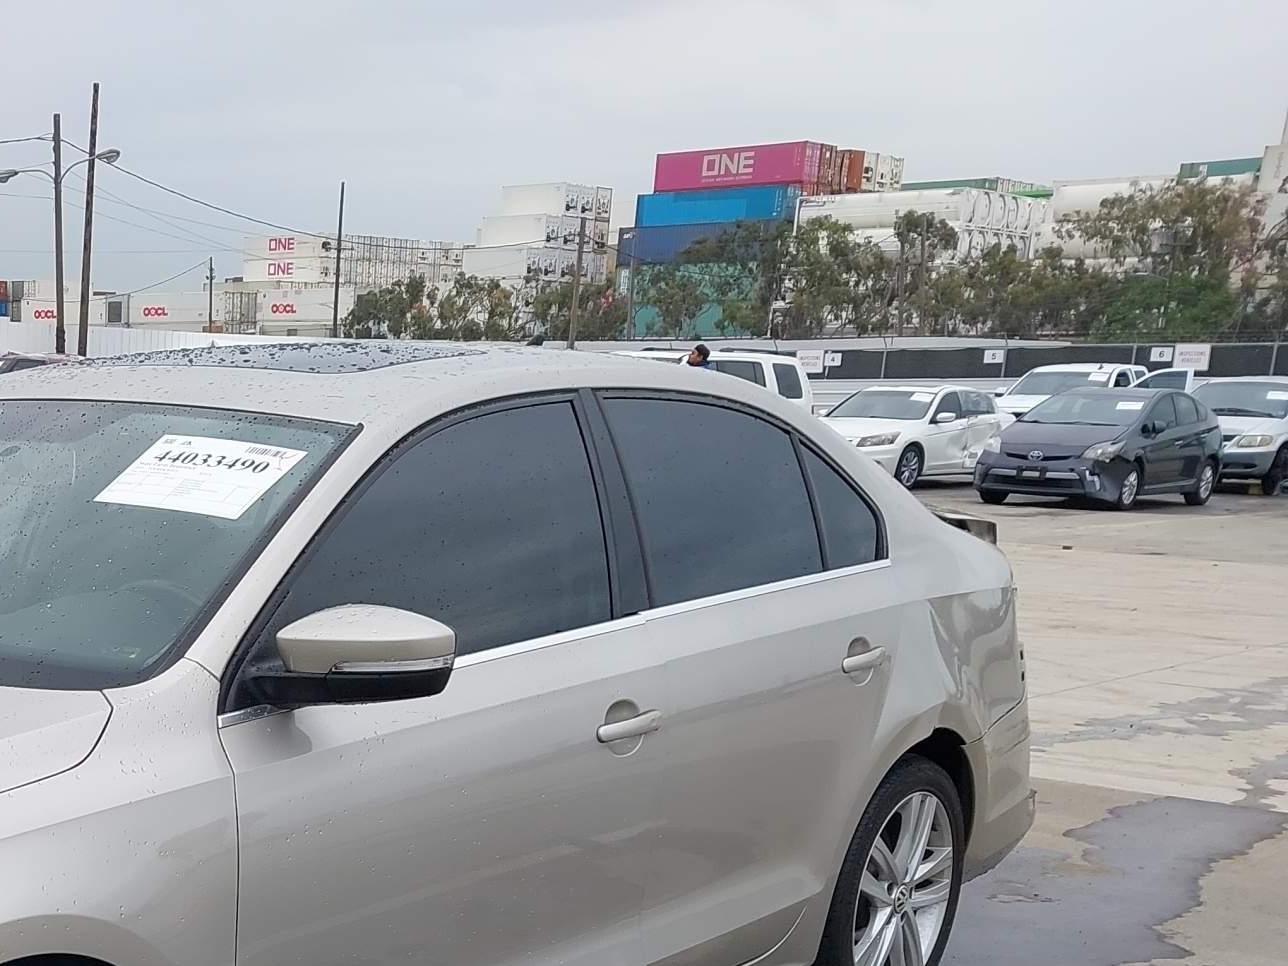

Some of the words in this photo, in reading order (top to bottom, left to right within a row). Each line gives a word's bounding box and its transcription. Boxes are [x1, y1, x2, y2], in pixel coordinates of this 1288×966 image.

[702, 152, 754, 176] ONE
[268, 237, 295, 251] ONE
[267, 262, 294, 276] ONE
[143, 307, 169, 318] OOCL
[270, 303, 297, 315] OOCL
[154, 450, 270, 473] 44033490
